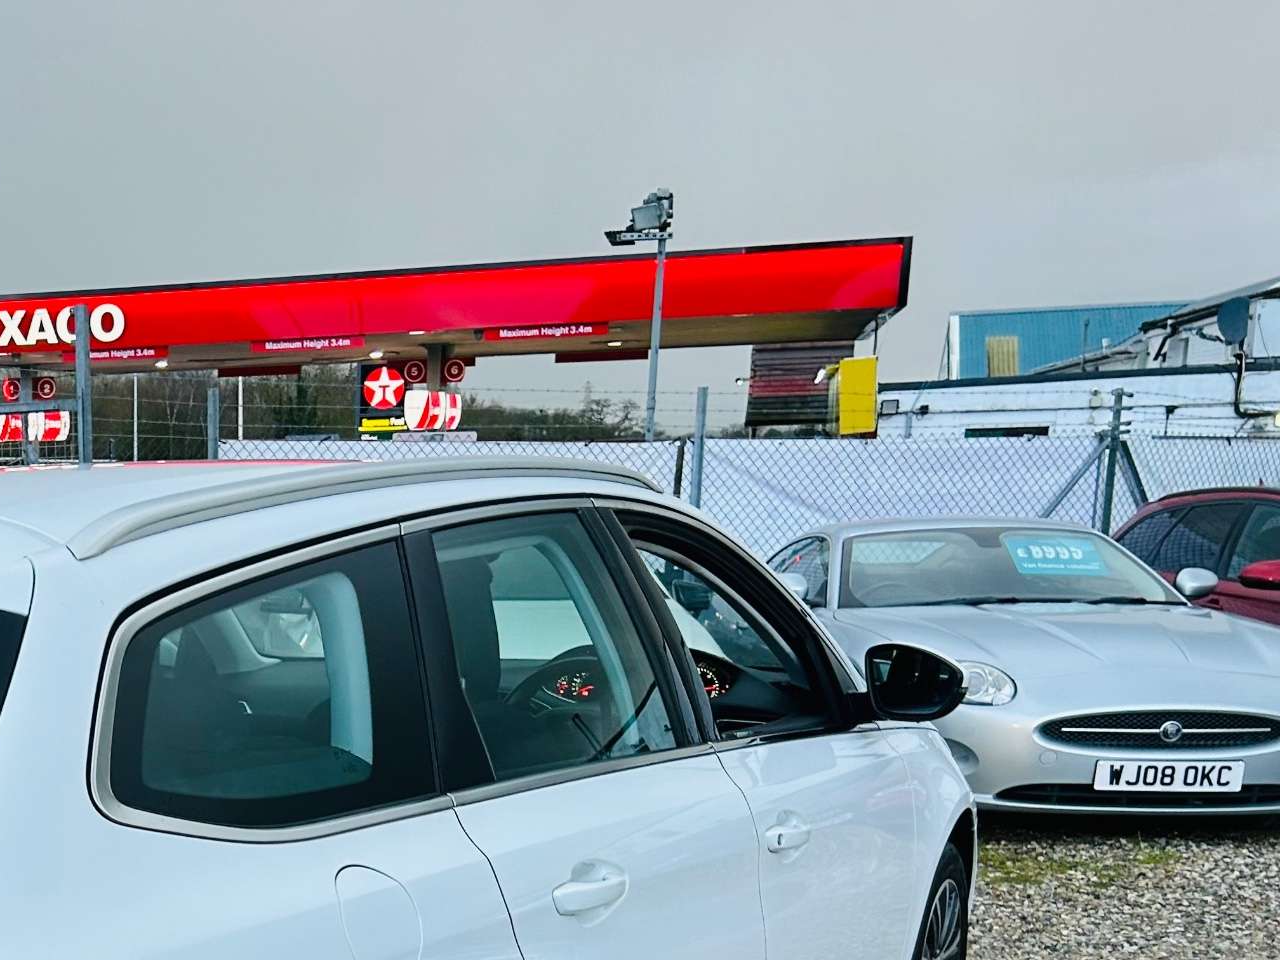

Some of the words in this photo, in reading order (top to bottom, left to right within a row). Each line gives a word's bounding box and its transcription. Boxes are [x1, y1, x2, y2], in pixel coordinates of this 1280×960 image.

[499, 328, 539, 338] Maximum
[540, 326, 569, 337] Height
[569, 325, 593, 334] 3.4m
[264, 341, 302, 350] Maximum
[303, 339, 329, 349] Height
[330, 338, 351, 347] 3.4m
[110, 349, 135, 359] Height
[135, 348, 155, 356] 3.4m
[1109, 764, 1176, 786] WJ08
[1183, 765, 1233, 787] OKC
